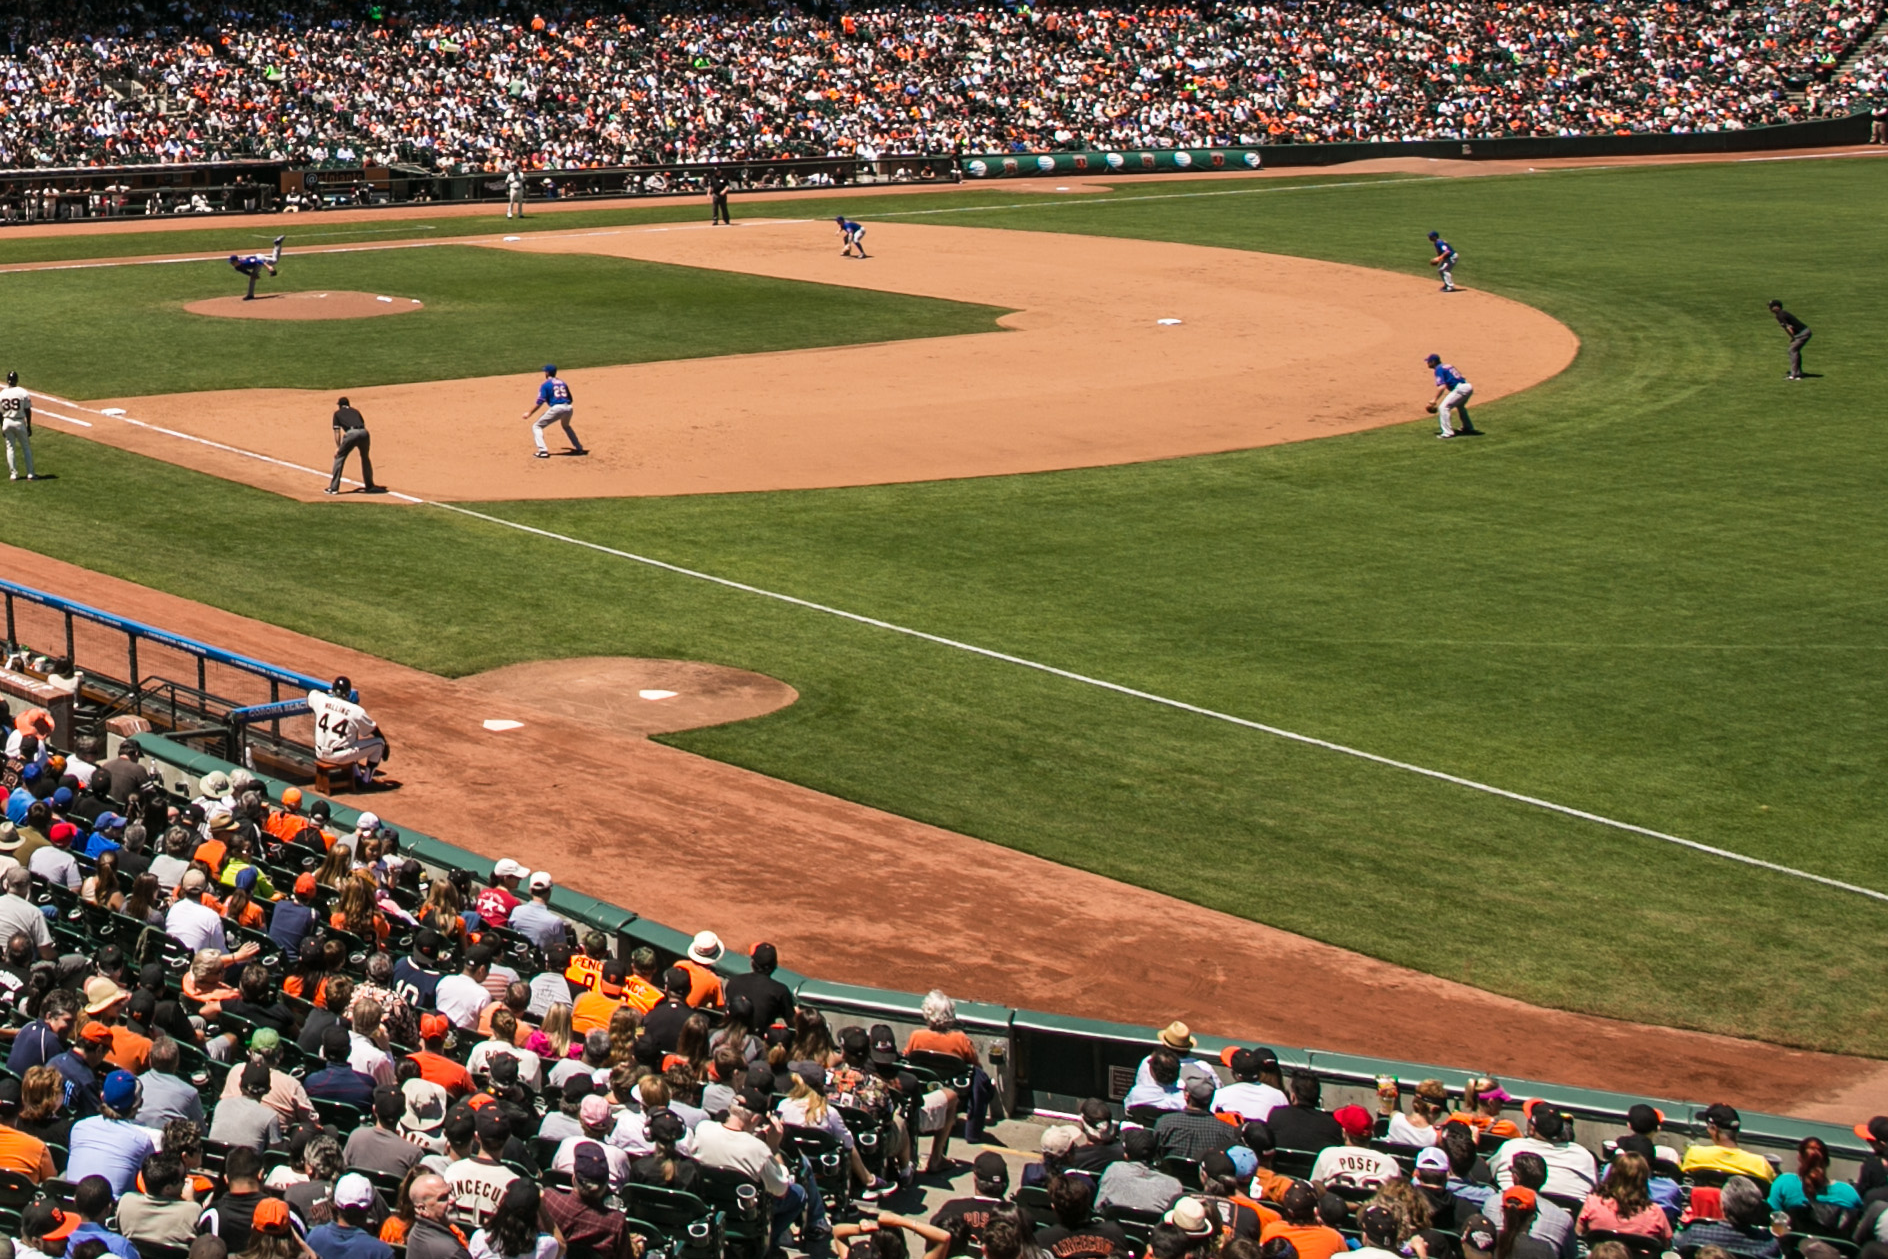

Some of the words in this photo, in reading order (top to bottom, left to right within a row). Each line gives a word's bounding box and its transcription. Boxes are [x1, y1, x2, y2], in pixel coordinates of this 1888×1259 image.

[2, 398, 21, 411] 39
[248, 705, 284, 718] CORONA
[318, 713, 348, 739] 44
[1338, 1156, 1381, 1174] POSEY
